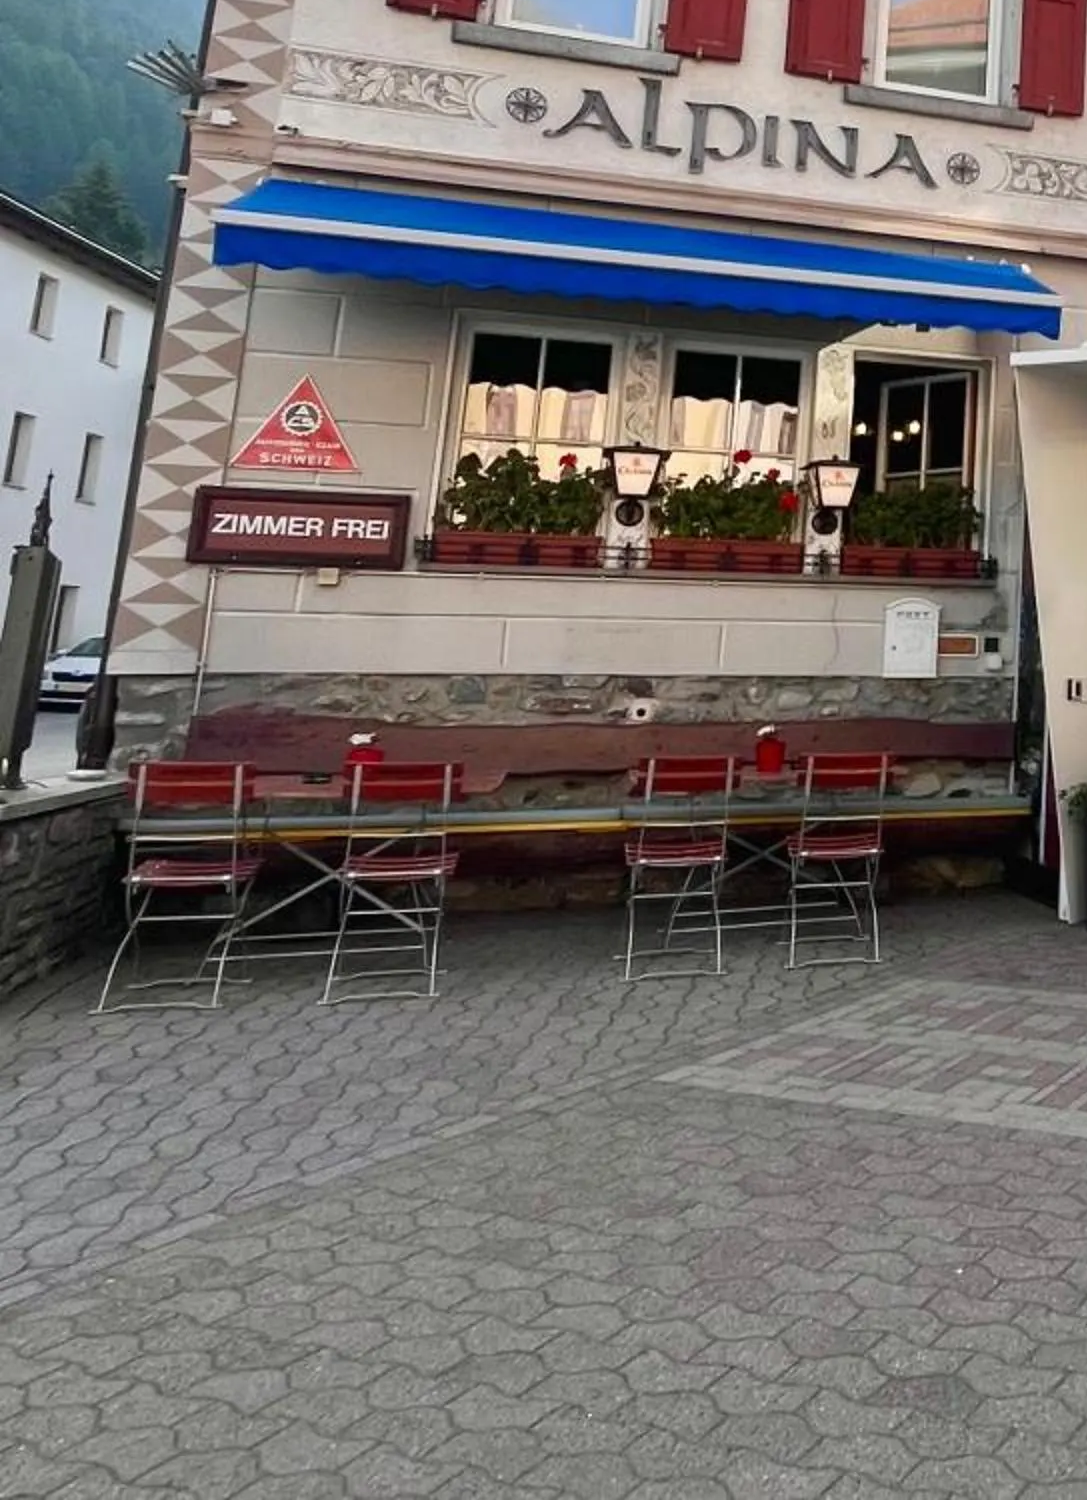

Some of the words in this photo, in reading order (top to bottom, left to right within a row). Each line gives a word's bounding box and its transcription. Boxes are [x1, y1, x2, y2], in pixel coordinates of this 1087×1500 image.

[542, 77, 937, 189] ALPINA
[259, 452, 333, 467] SCHWEIZ
[211, 513, 325, 537] ZIMMER
[331, 518, 390, 539] FREI
